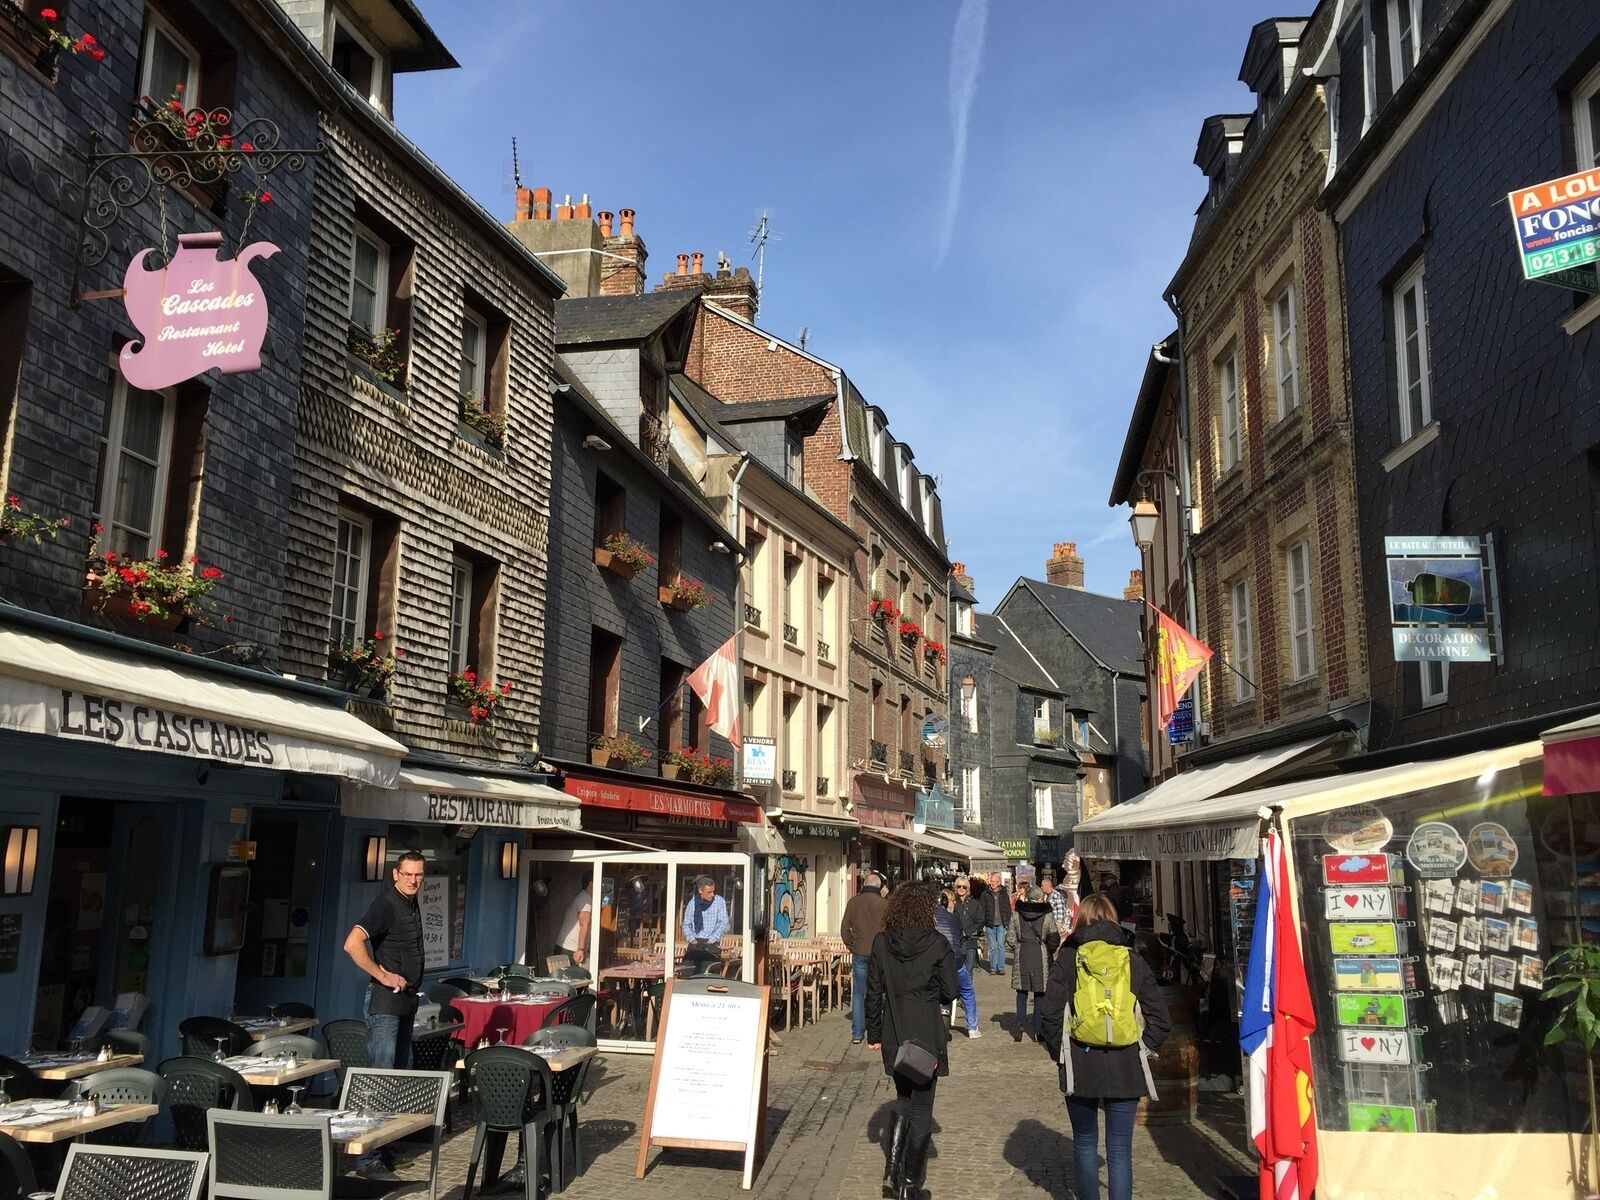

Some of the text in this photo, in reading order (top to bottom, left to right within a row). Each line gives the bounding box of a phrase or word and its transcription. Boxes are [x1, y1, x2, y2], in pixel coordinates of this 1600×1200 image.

[1521, 192, 1543, 212] A
[1532, 253, 1554, 270] 02
[187, 278, 214, 294] Les
[161, 290, 254, 316] Cascades
[158, 320, 240, 341] Restaurant
[1400, 632, 1482, 644] DECORATION
[1415, 646, 1470, 656] MARINE
[60, 690, 274, 764] LES CASCADES
[428, 794, 524, 825] RESTAURANT
[650, 794, 664, 810] LES
[666, 797, 711, 817] MARMOTTES
[1330, 895, 1340, 910] I
[1347, 1037, 1358, 1052] I
